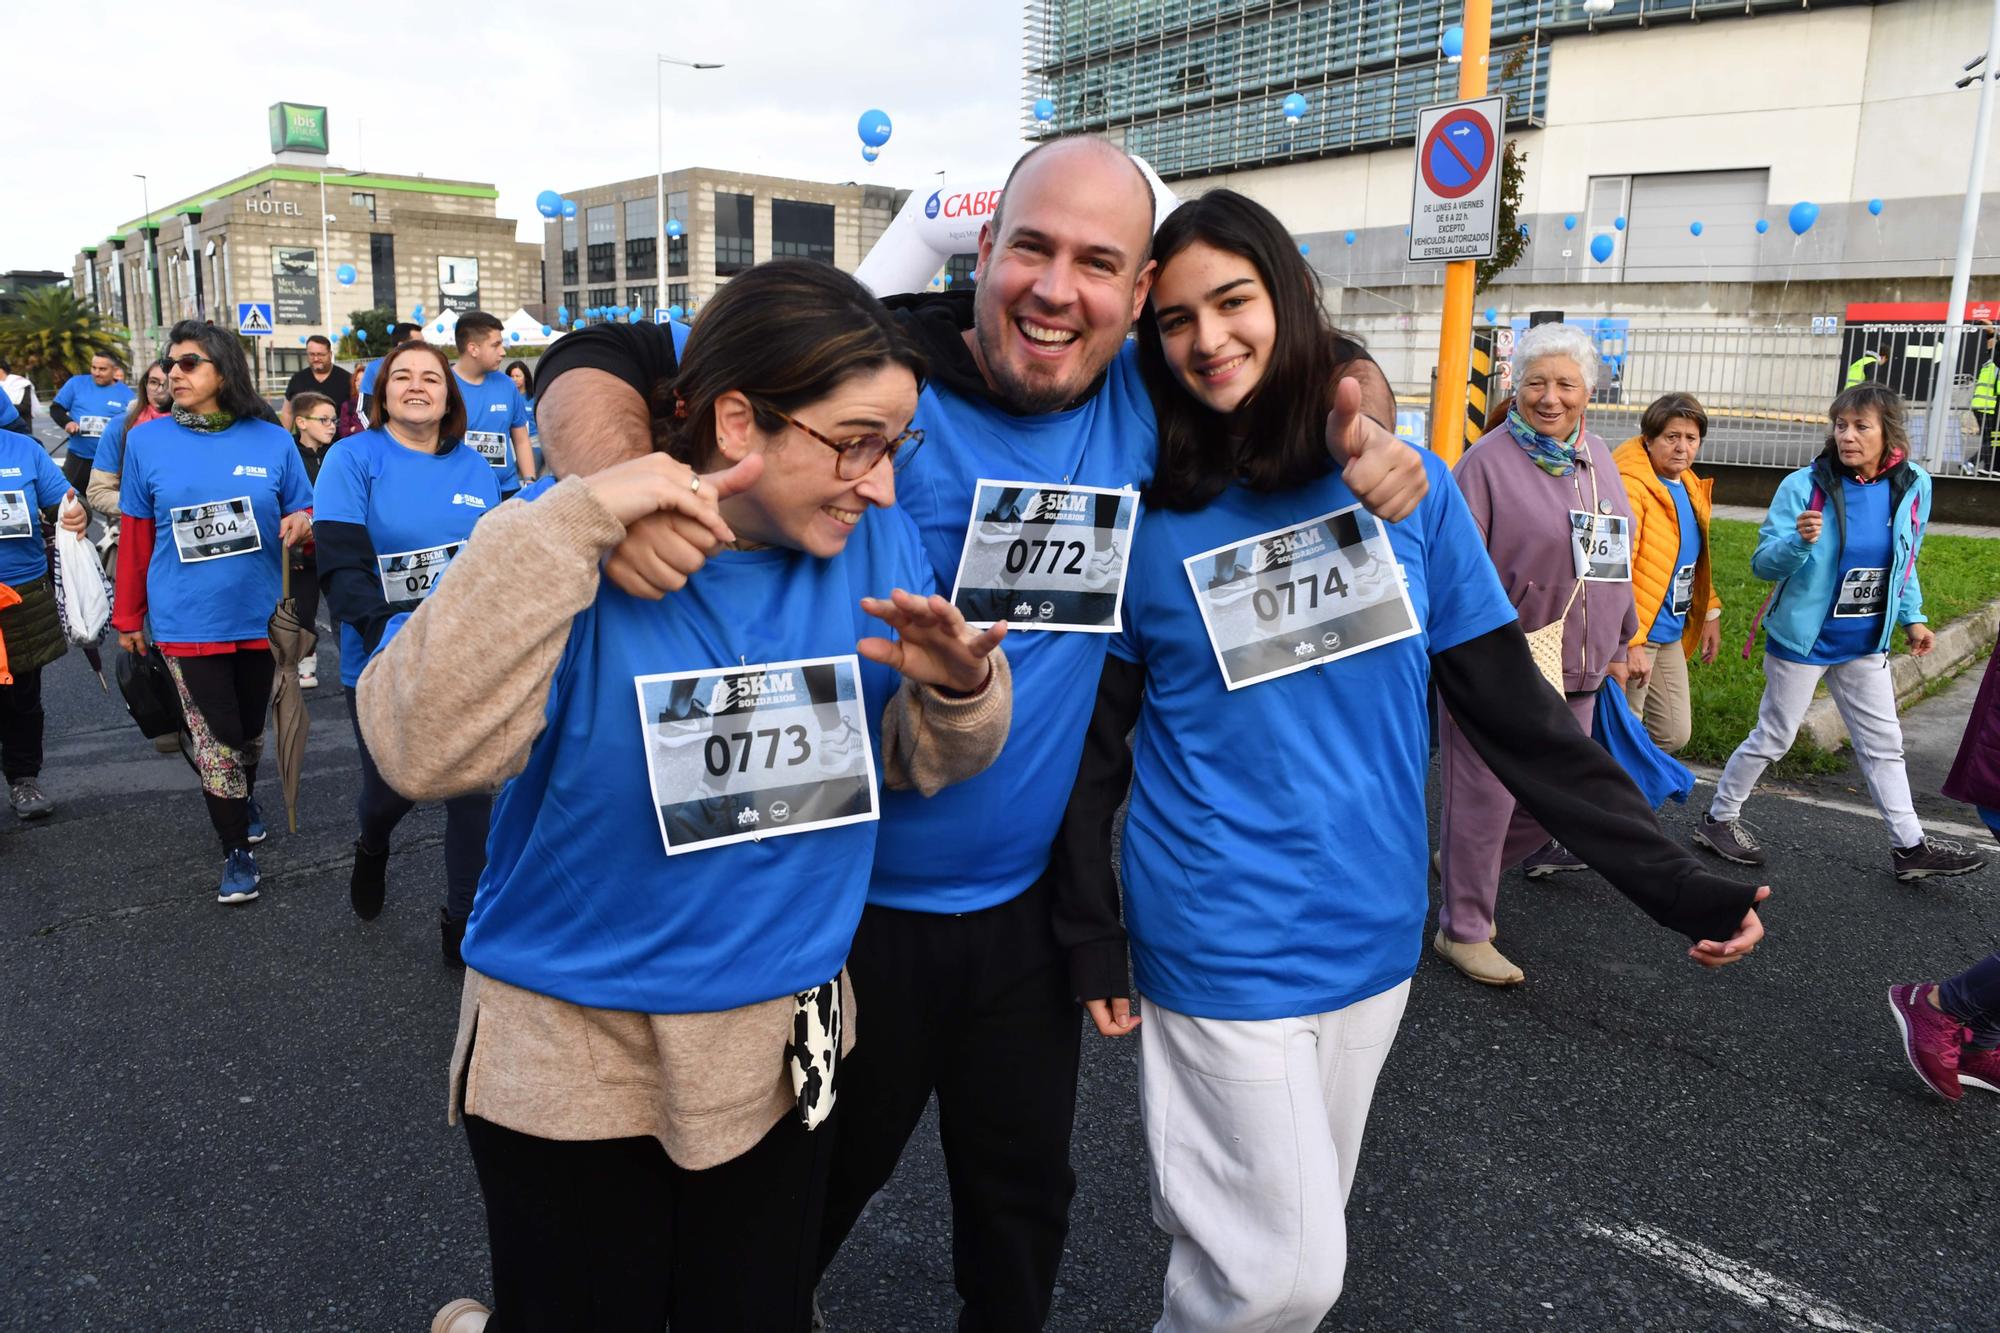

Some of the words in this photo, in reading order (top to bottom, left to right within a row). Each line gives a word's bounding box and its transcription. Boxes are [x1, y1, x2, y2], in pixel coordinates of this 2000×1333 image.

[294, 114, 316, 127] ibis
[246, 200, 303, 216] HOTEL
[1433, 202, 1452, 211] LUNES
[1458, 199, 1484, 209] VIERNES
[1436, 214, 1444, 222] DE
[1445, 214, 1449, 222] 6
[1455, 213, 1462, 221] 22
[1438, 223, 1466, 233] EXCEPTO
[1447, 233, 1489, 244] AUTORIZADOS
[1424, 246, 1453, 256] ESTRELLA
[1454, 245, 1478, 254] GALICIA
[443, 297, 457, 306] ibis
[658, 311, 670, 323] P
[477, 444, 499, 454] 0287
[1046, 494, 1088, 512] 5KM
[1044, 512, 1085, 520] SOLIDARIOS
[194, 520, 238, 539] 0204
[1273, 528, 1322, 555] 5KM
[420, 550, 444, 562] 5KM
[1006, 538, 1086, 575] 0772
[1277, 543, 1326, 565] SOLIDARIOS
[1252, 566, 1349, 622] 0774
[737, 672, 795, 698] 5KM
[738, 694, 797, 708] SOLIDARIOS
[704, 724, 812, 777] 0773
